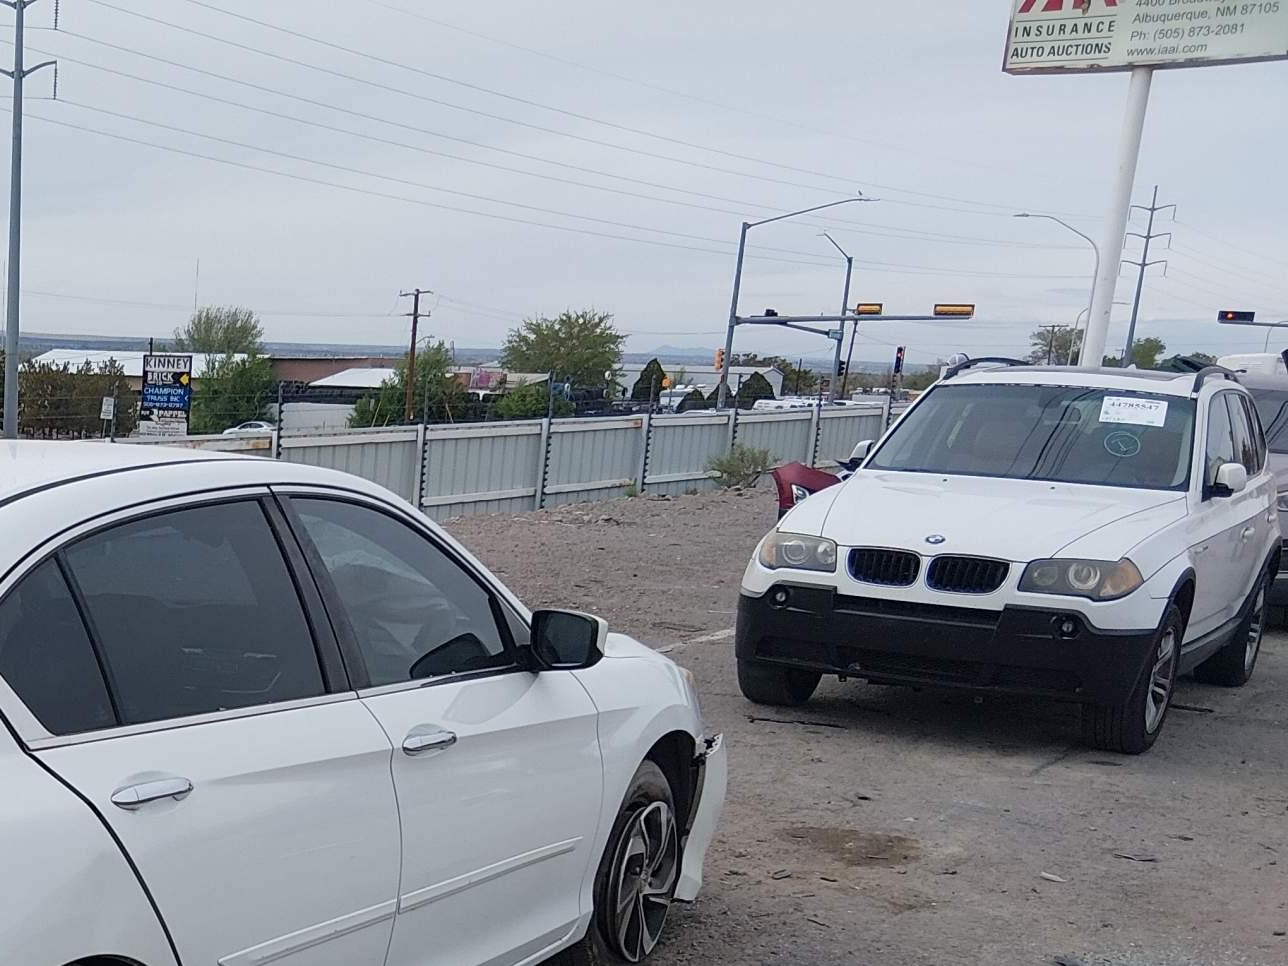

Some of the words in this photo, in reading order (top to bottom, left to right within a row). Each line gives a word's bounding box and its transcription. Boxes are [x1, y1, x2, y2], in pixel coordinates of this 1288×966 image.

[1132, 9, 1210, 24] Albuquerque,
[1215, 6, 1237, 17] NM
[1240, 2, 1280, 15] 87105
[1014, 20, 1116, 38] INSURANCE
[1130, 30, 1149, 41] Ph:
[1153, 29, 1185, 41] (505)
[1188, 23, 1245, 37] 873-2081
[1010, 46, 1044, 59] AUTO
[1047, 42, 1112, 57] AUCTIONS
[1127, 44, 1208, 56] www.iaai.com
[145, 358, 189, 369] KINNEY
[147, 372, 174, 381] BRICK
[143, 387, 184, 395] CHAMPION
